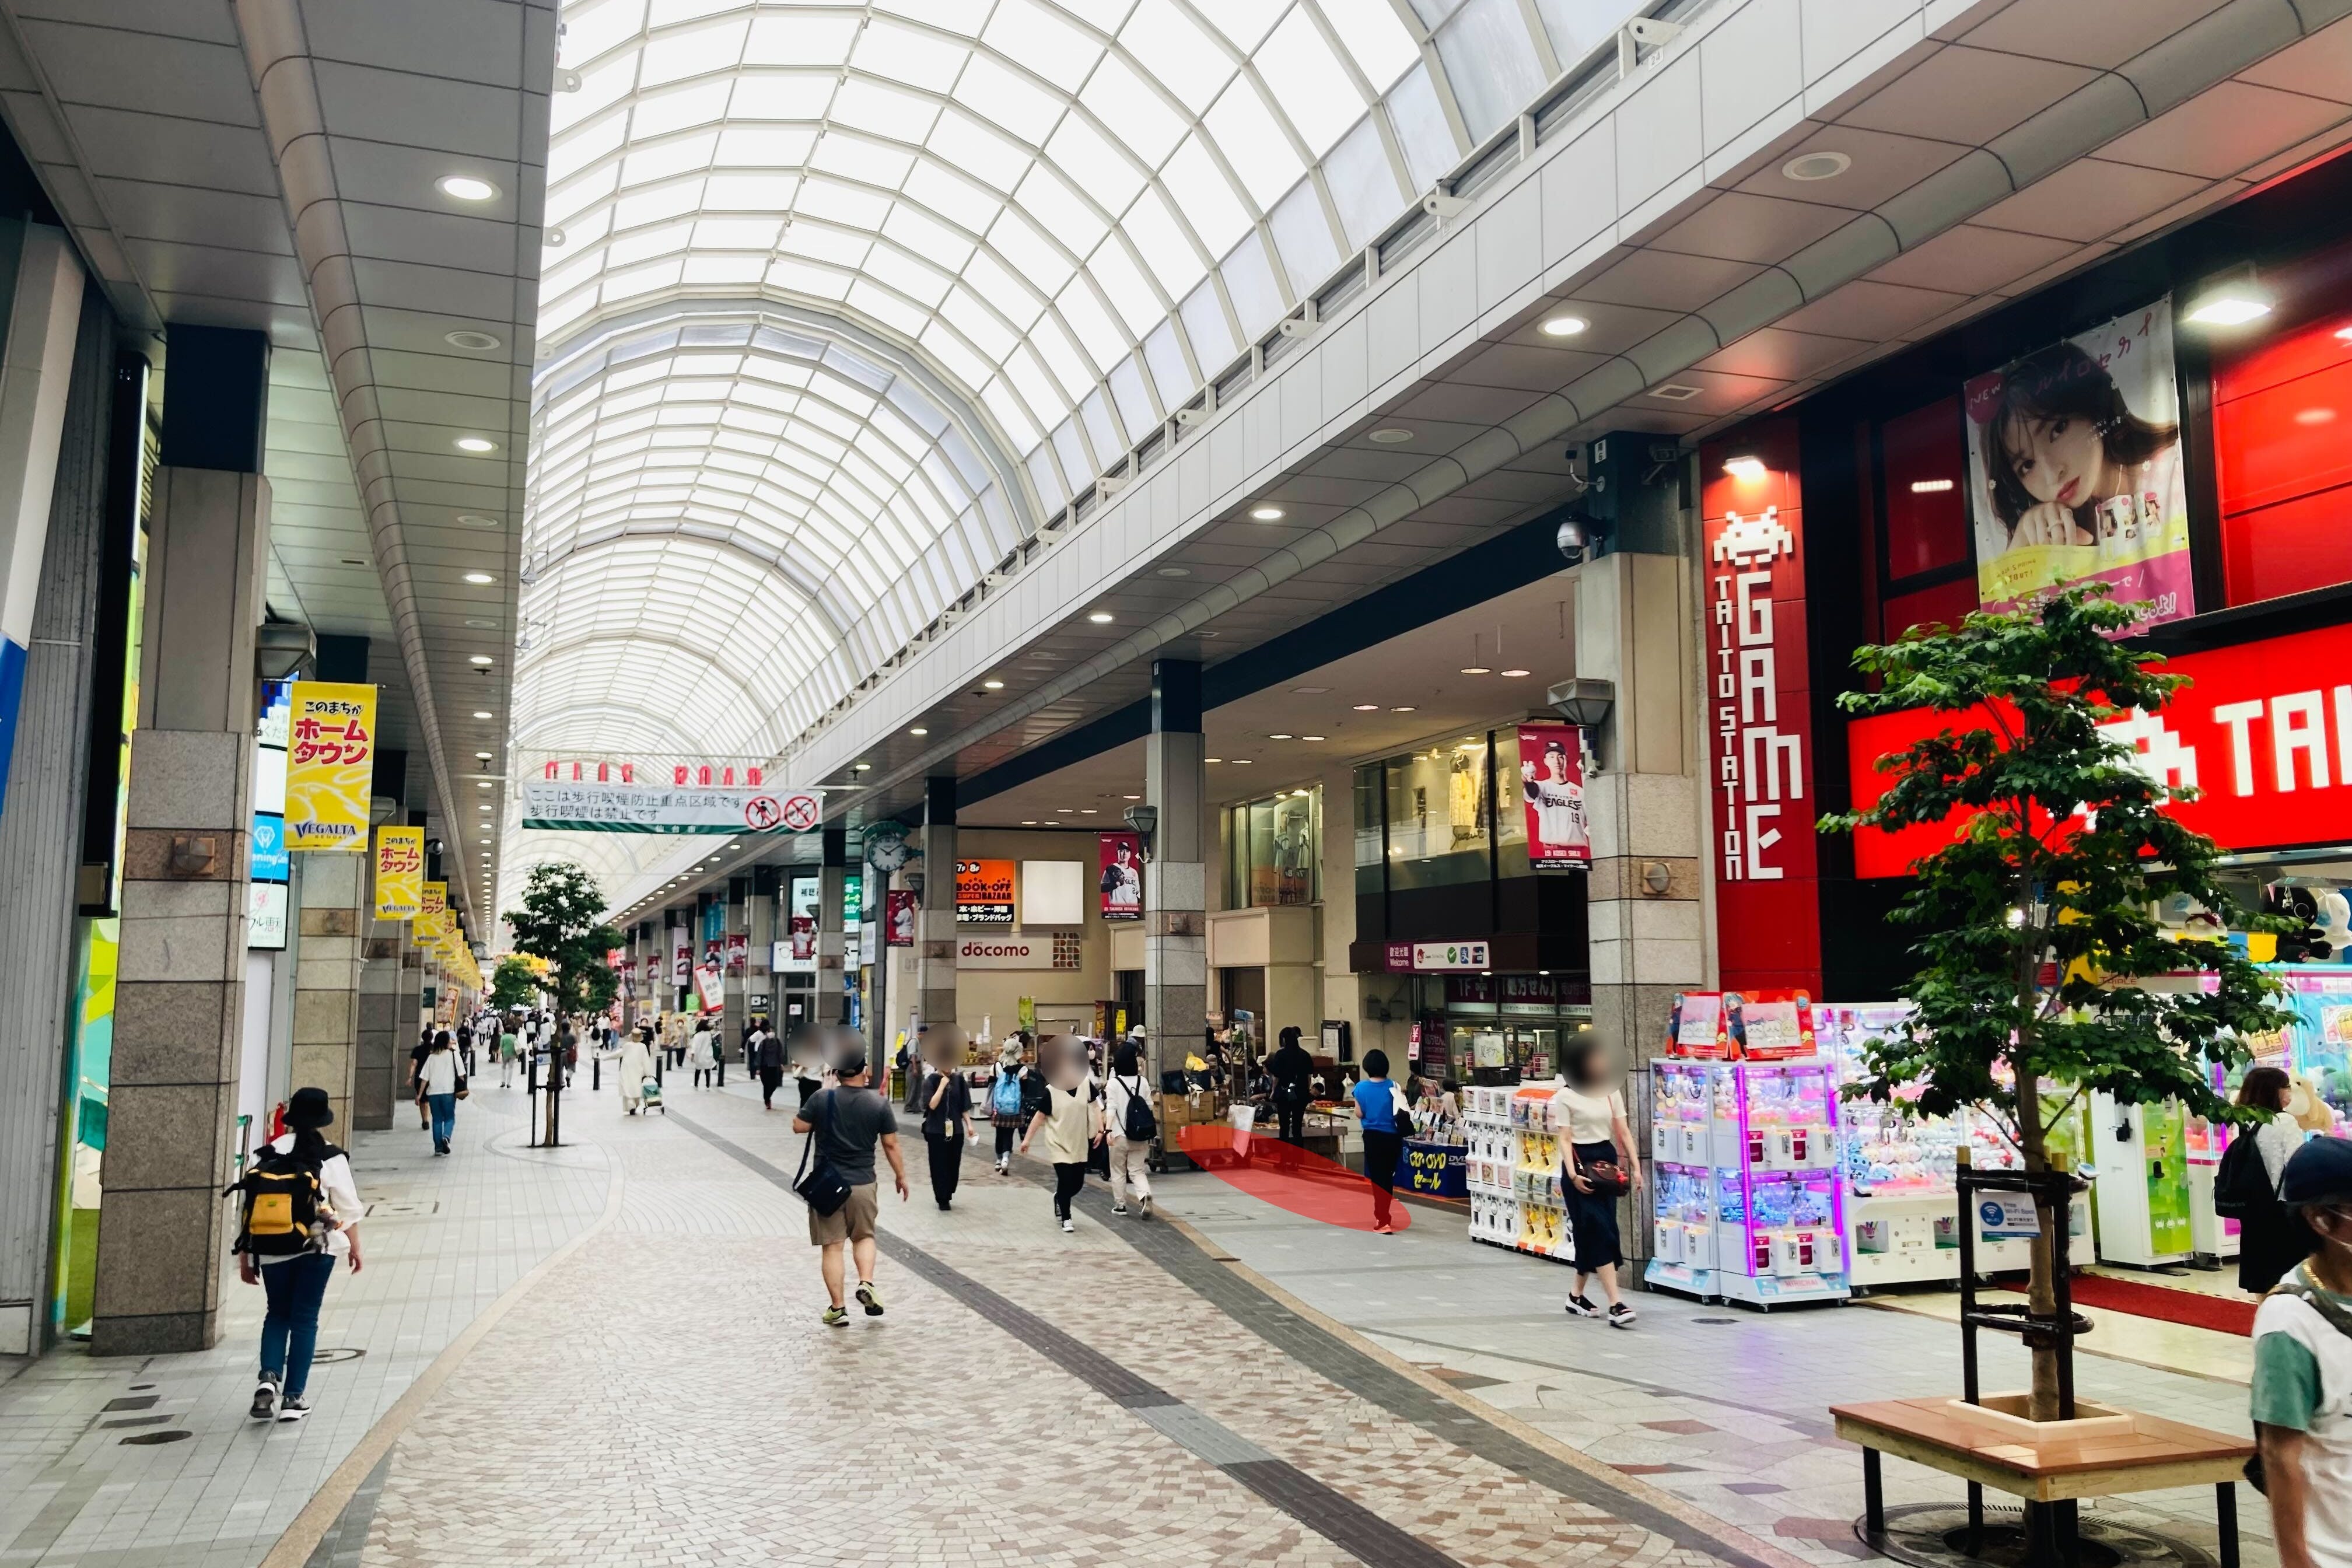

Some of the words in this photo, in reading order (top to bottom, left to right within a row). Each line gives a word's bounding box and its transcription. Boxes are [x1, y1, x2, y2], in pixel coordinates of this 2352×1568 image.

[1970, 382, 2001, 409] NEW
[1715, 575, 1735, 698] TAITO
[305, 701, 362, 715] このまちが
[295, 718, 368, 741] ホーム
[1737, 570, 1803, 880] GAME
[294, 741, 368, 765] タウン
[532, 790, 743, 808] ここは歩行喫煙防止重点区域です
[1720, 706, 1742, 880] STATION
[530, 804, 660, 821] 歩行喫煙は禁止です
[1572, 813, 1580, 823] 19
[295, 820, 357, 838] VEGALTA
[381, 847, 420, 859] ホーム
[380, 860, 420, 873] タウン
[970, 864, 980, 872] 8F
[961, 942, 1030, 957] docomo
[1390, 958, 1409, 967] Welcome
[1413, 1170, 1441, 1190] セール
